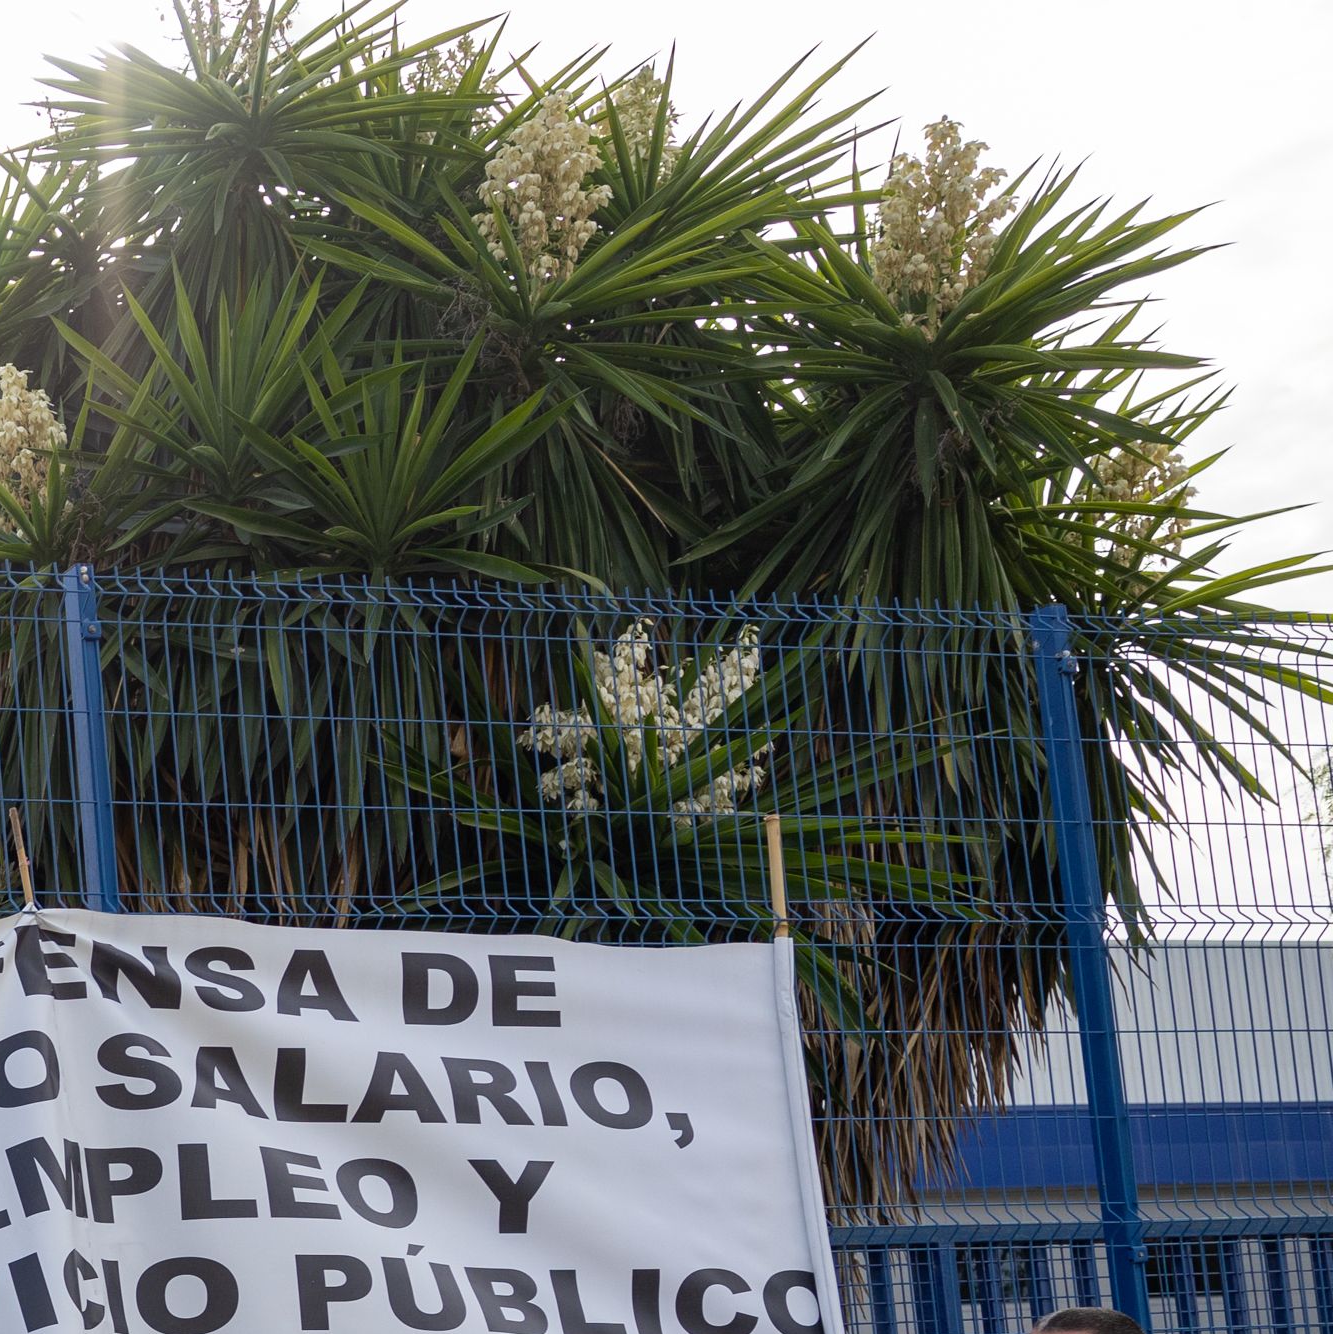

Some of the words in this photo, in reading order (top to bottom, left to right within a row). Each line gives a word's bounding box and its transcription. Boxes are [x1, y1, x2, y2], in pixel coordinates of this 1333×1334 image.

[401, 952, 562, 1028] DE
[95, 1031, 696, 1149] SALARIO,
[466, 1158, 555, 1234] Y
